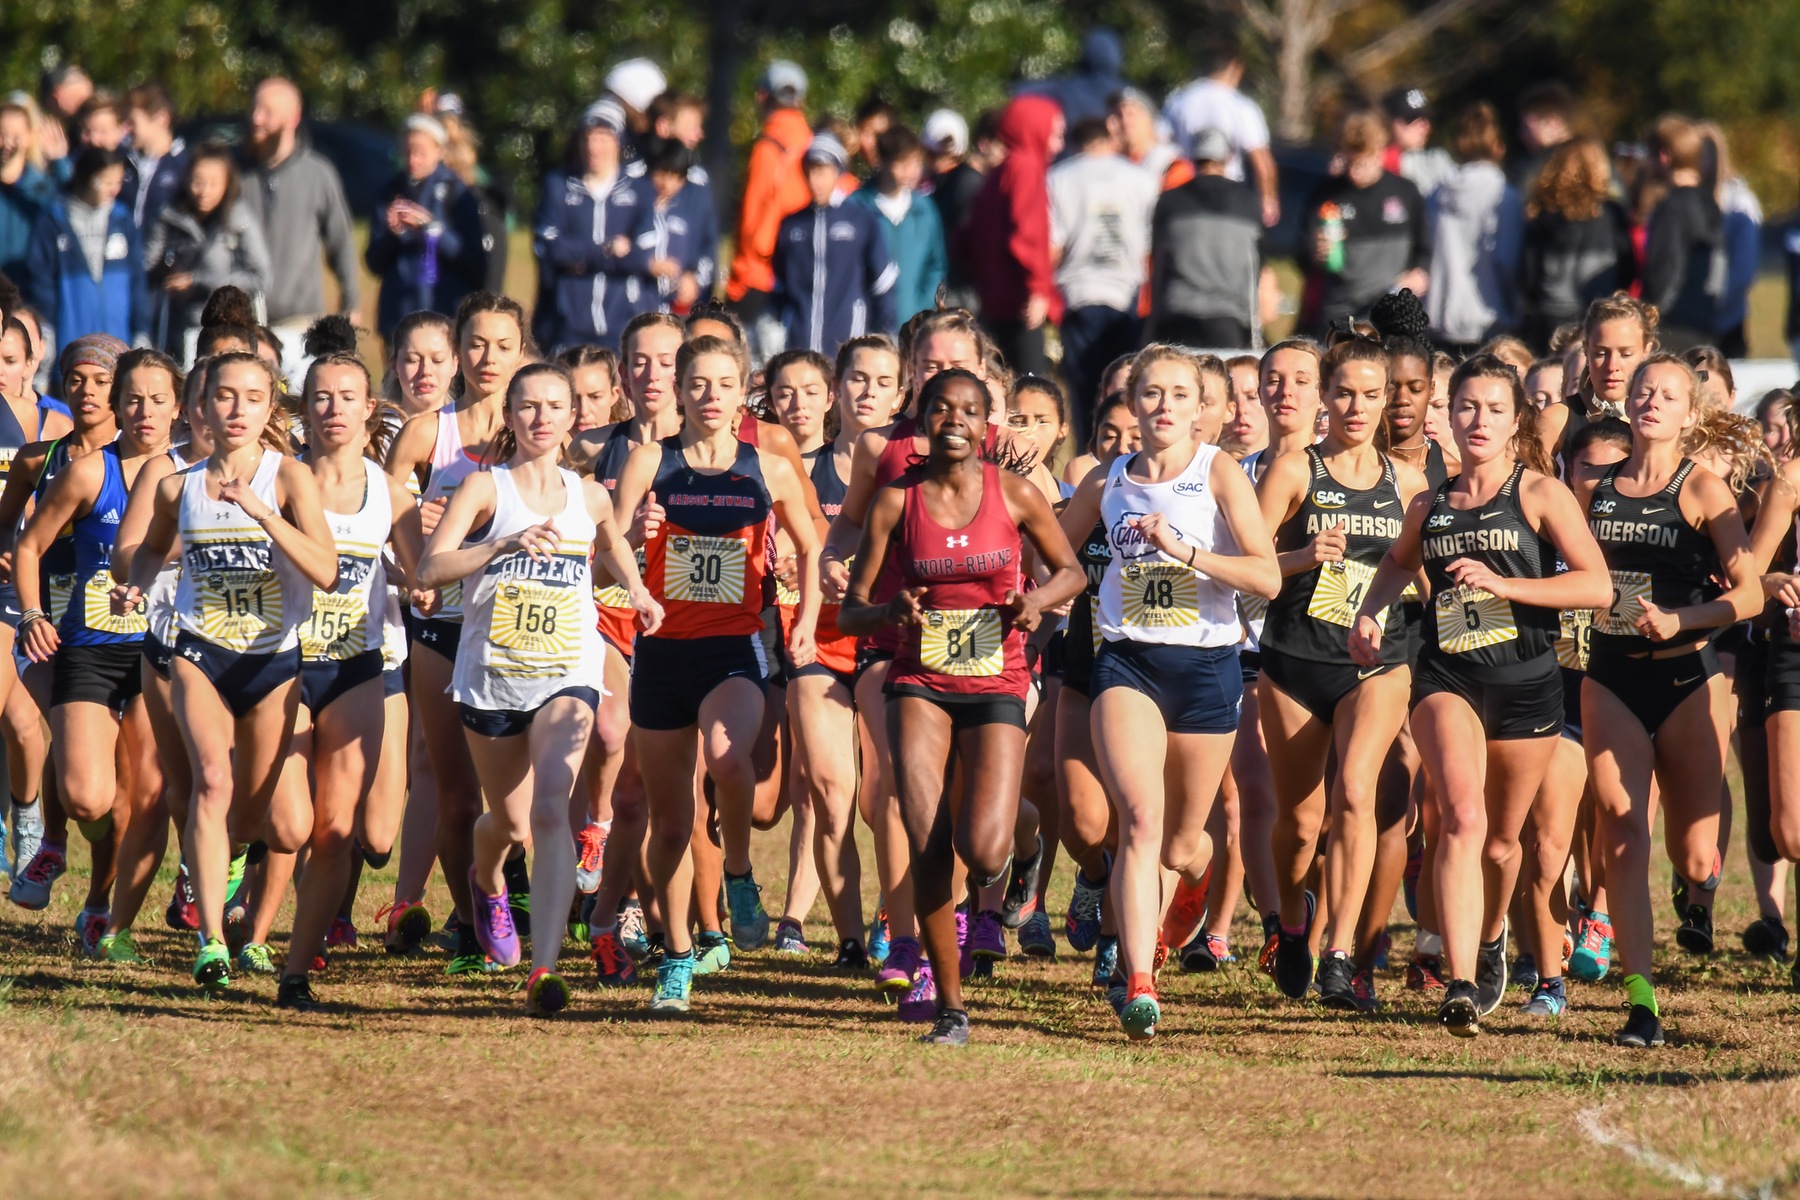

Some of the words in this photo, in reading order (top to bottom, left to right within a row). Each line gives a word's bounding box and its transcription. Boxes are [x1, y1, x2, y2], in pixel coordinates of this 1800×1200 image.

[1177, 482, 1203, 492] SAC
[1316, 490, 1346, 505] SAC
[1428, 514, 1455, 528] SAC
[1592, 500, 1617, 514] SAC
[1422, 528, 1520, 561] ANDERSON
[1590, 519, 1679, 548] NDERSON
[501, 554, 586, 586] QUEENS
[689, 553, 722, 585] 30
[221, 586, 264, 618] 151
[1142, 579, 1174, 610] 48
[1345, 582, 1364, 611] 4
[305, 609, 352, 643] 155
[514, 602, 557, 635] 158
[1462, 600, 1481, 630] 5
[946, 628, 976, 659] 81
